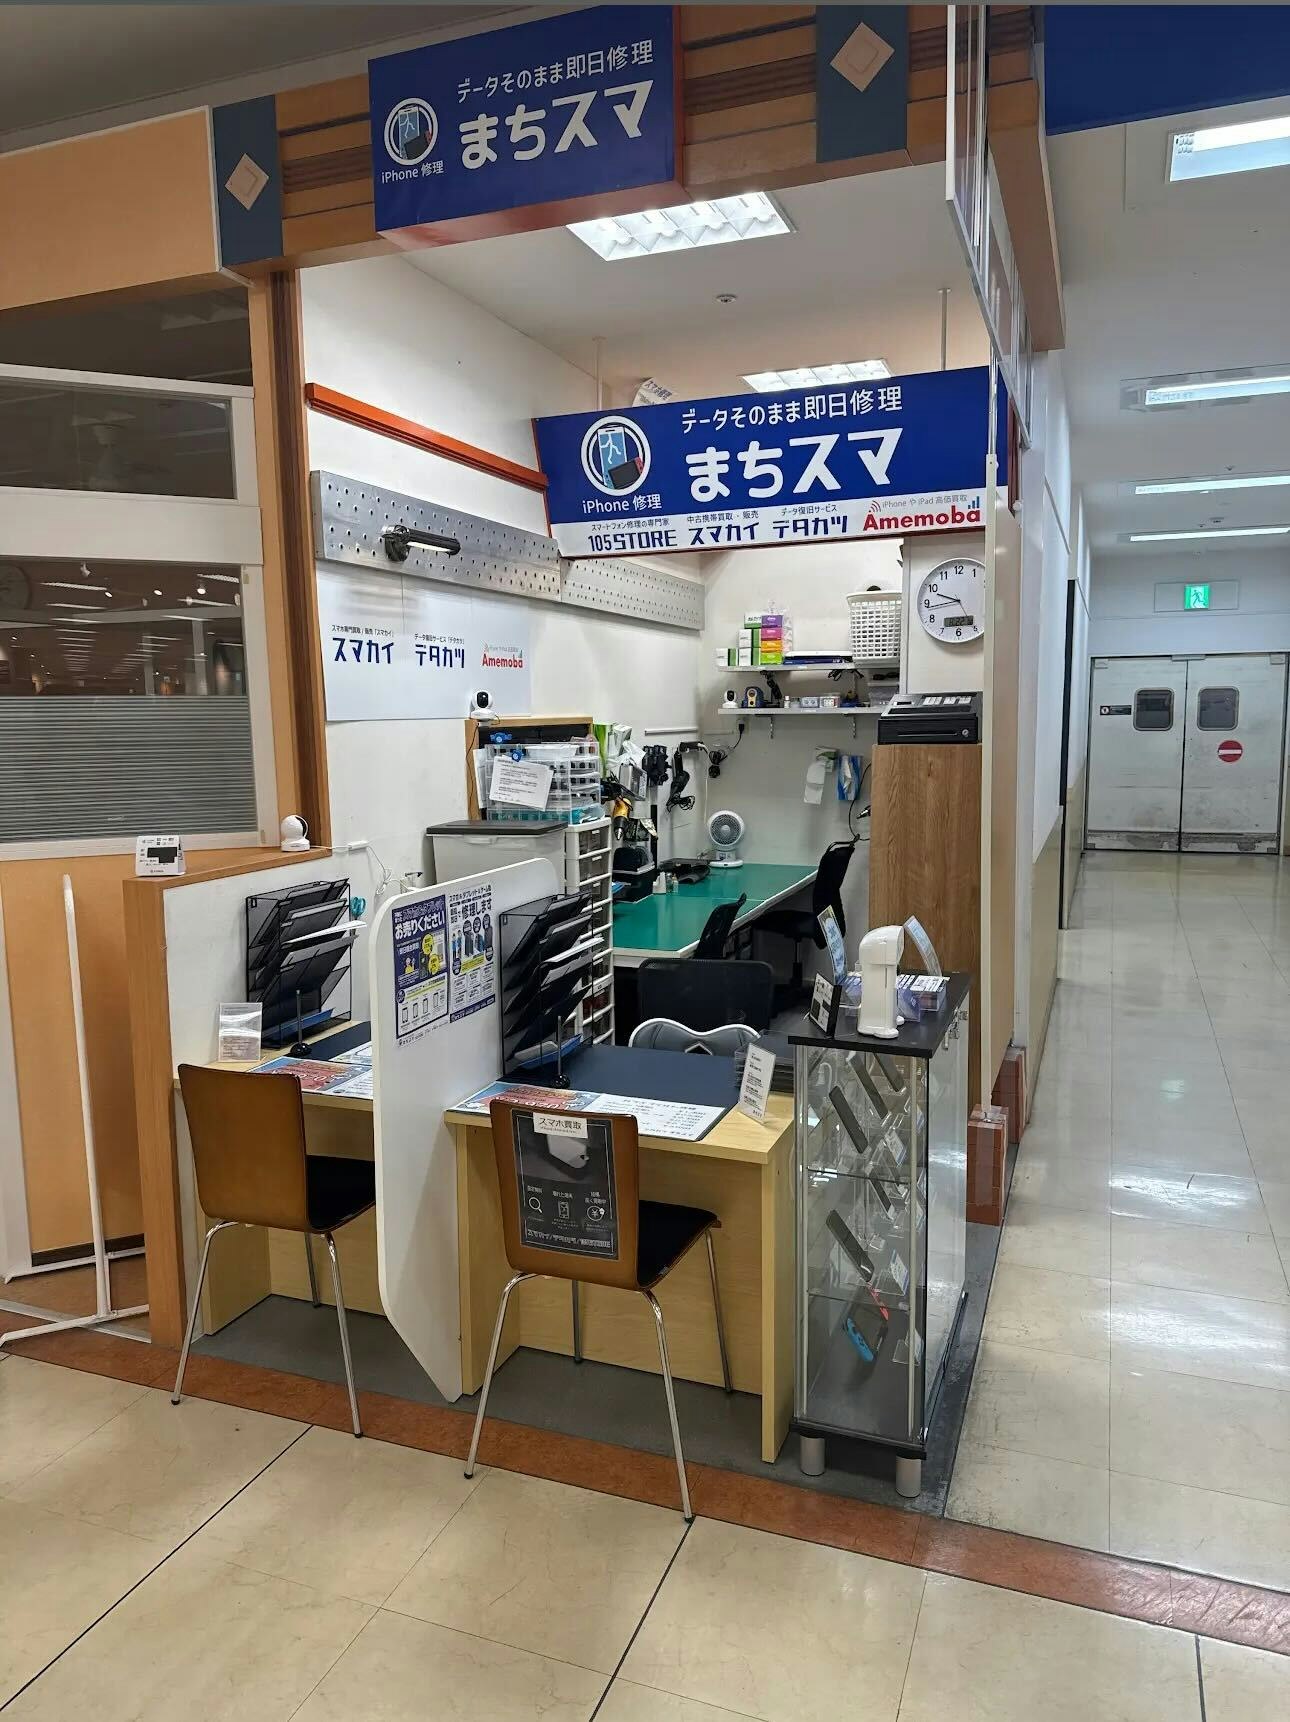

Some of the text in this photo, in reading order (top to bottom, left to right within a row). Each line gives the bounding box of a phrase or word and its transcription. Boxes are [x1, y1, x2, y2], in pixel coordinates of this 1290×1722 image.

[457, 40, 654, 104] データそのまま即日修理
[458, 79, 654, 170] まちスマ
[381, 160, 444, 184] iPhone 修理
[681, 386, 903, 435] データそのまま即日修理
[685, 427, 904, 503] まちスマ
[582, 493, 663, 514] iPhone 修理
[780, 503, 838, 517] データ復旧サービス
[882, 499, 907, 509] iPhone
[909, 498, 917, 506] や
[918, 496, 934, 506] iPad
[591, 518, 670, 532] スマートフォン修理の専門家
[772, 515, 848, 539] デタカツ
[862, 505, 981, 532] Amemoba
[688, 521, 760, 546] スマカイ
[940, 571, 948, 580] 11
[955, 566, 964, 575] 12
[928, 584, 938, 593] 10
[924, 599, 930, 608] 9
[929, 615, 935, 623] 8
[956, 628, 962, 637] 6
[332, 637, 394, 664] スマカイ
[415, 643, 465, 669] デタカツ
[482, 651, 523, 668] Amemoba
[539, 1117, 582, 1130] スマホ買取
